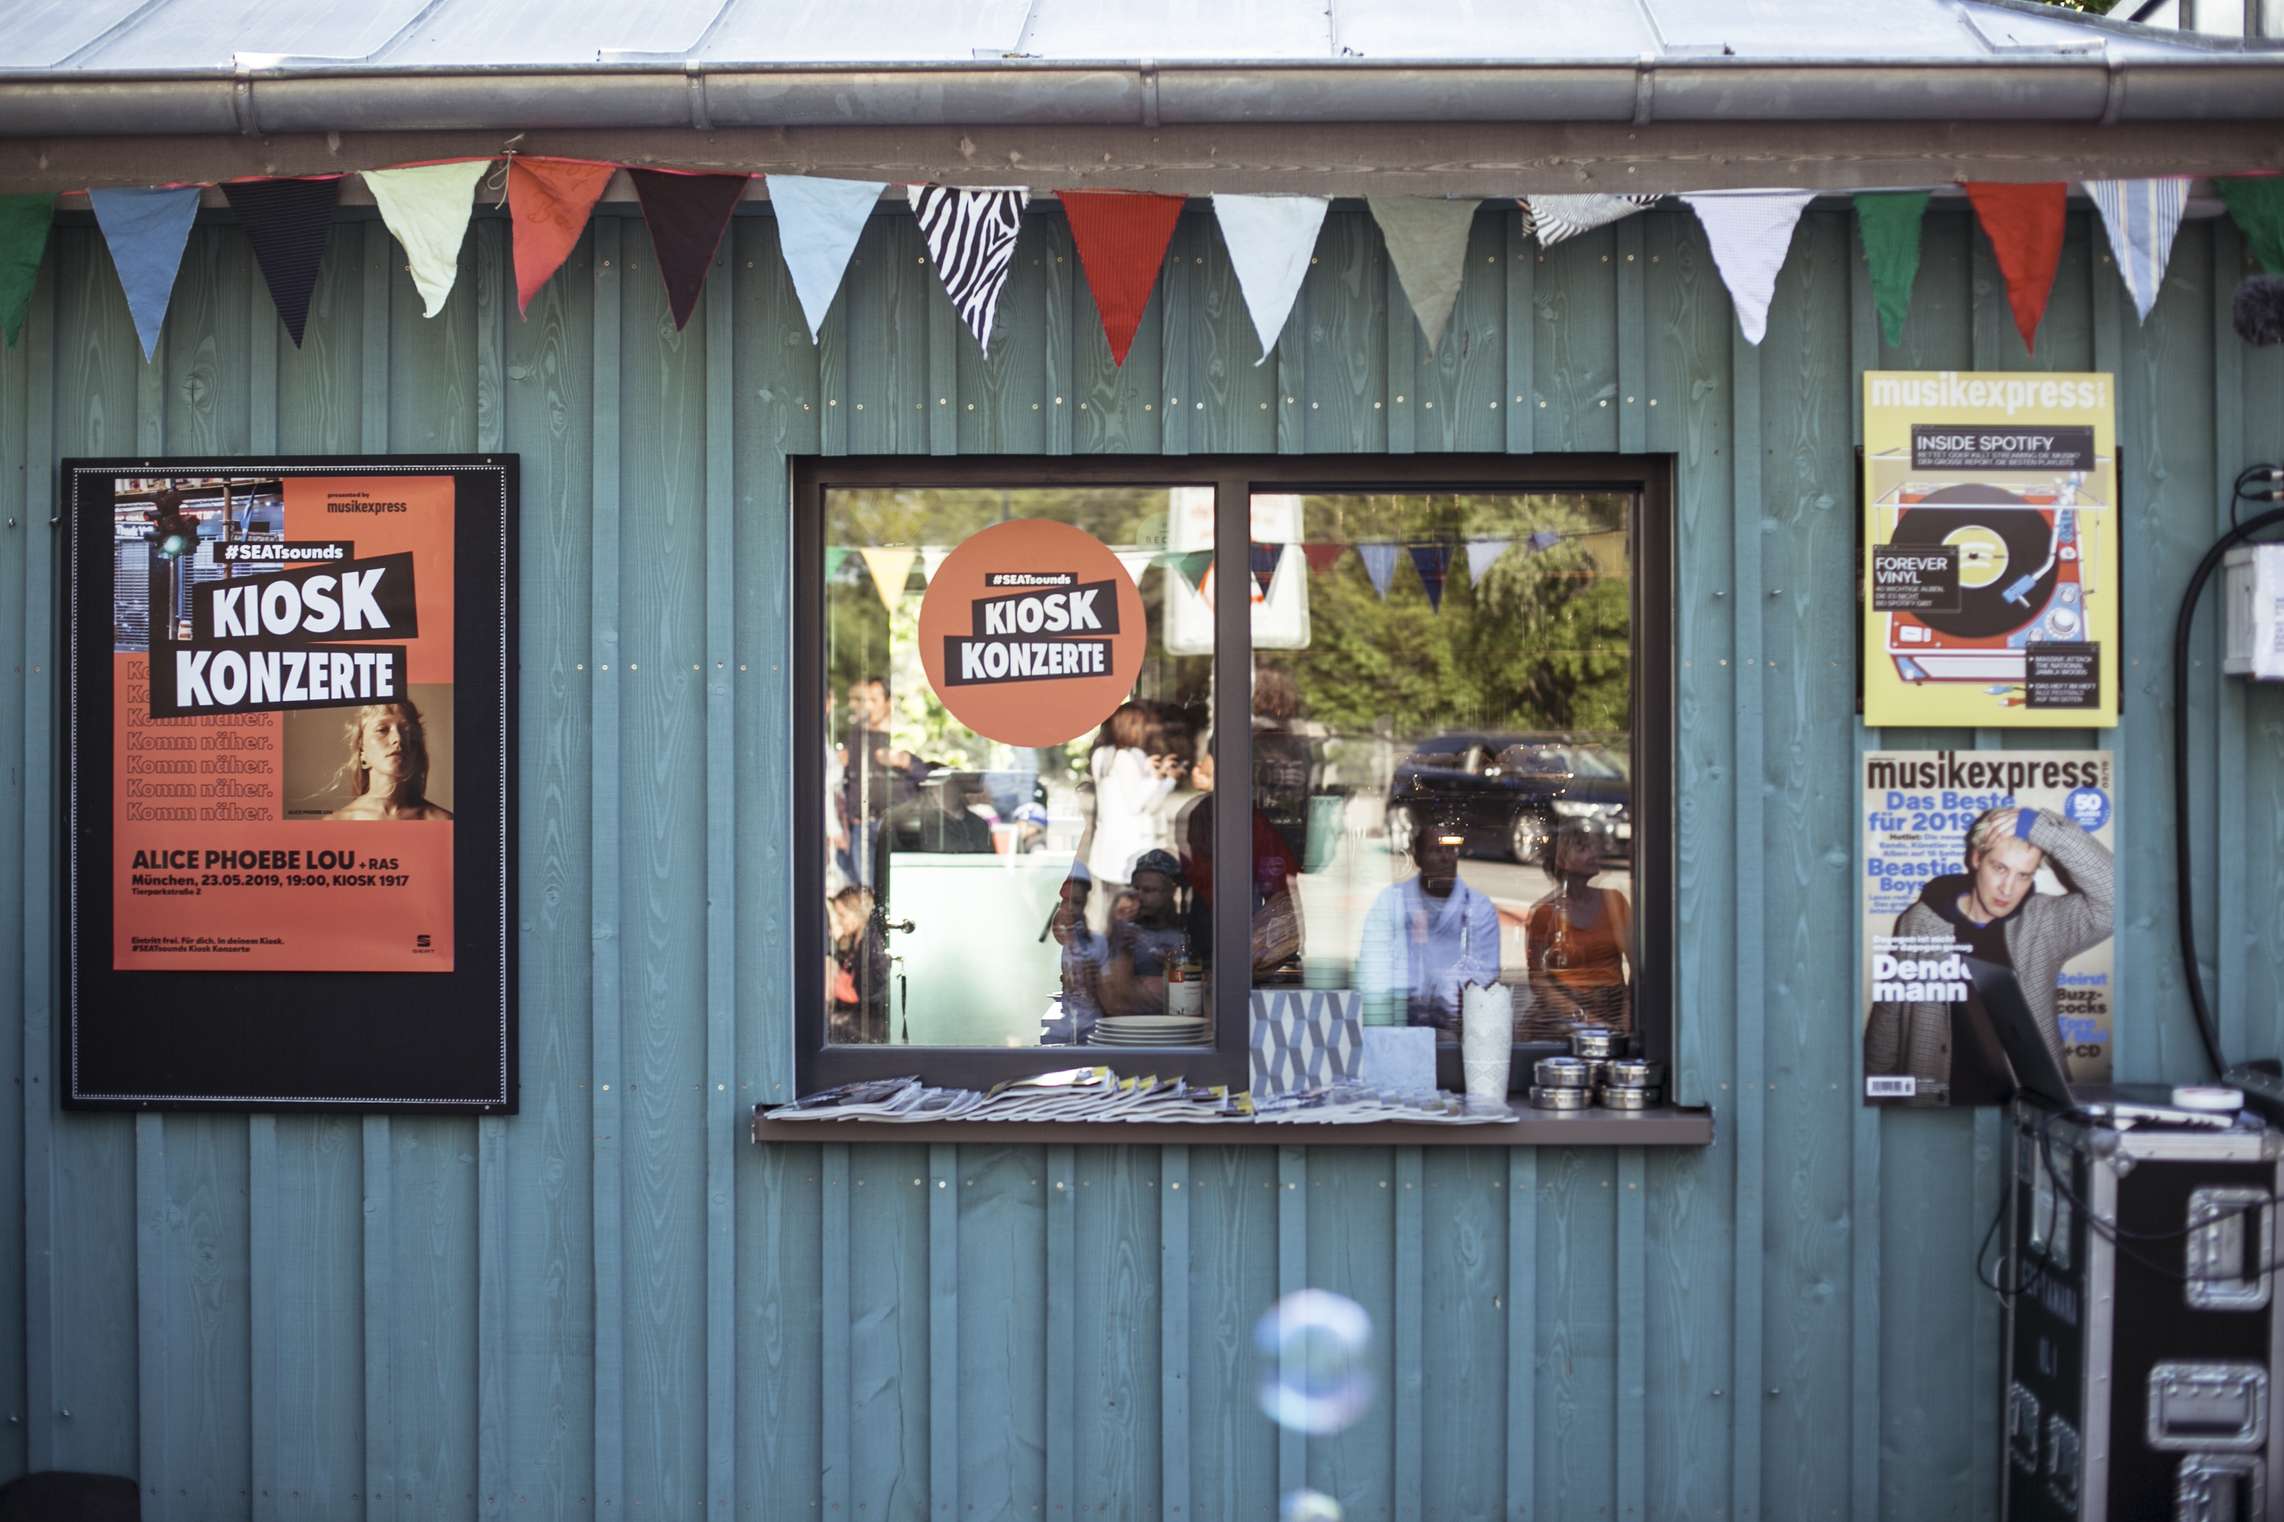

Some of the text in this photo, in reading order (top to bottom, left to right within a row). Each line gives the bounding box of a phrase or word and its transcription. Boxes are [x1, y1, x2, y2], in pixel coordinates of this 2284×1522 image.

[1871, 371, 2097, 416] musikexpress
[1917, 436, 2055, 450] INSIDE SPOTIFY
[327, 500, 407, 516] musikexpress
[225, 544, 344, 560] #SEATsounds
[1875, 557, 1948, 570] FOREVER
[992, 574, 1071, 585] #SEATsounds
[1876, 571, 1922, 584] VINYL
[212, 567, 391, 638] KIOSK
[984, 589, 1102, 636] KIOSK
[961, 641, 1105, 680] KONZERTE
[176, 650, 394, 708] KONZERTE
[127, 732, 274, 751] Komm näher.
[127, 755, 274, 774] Komm näher.
[1868, 751, 2098, 796] musikexpress
[127, 779, 274, 798] Komm näher.
[1887, 791, 2016, 810] Das Beste
[2074, 794, 2102, 810] 50
[127, 802, 274, 821] Komm näher.
[1868, 812, 1974, 831] für 2019
[132, 849, 199, 870] ALICE
[205, 849, 300, 870] PHOEBE
[306, 849, 355, 870] LOU
[368, 859, 399, 870] RAS
[1868, 858, 1962, 876] Beastie
[132, 874, 409, 887] München, 23.05.2019, 19:00, KIOSK 1917
[132, 888, 194, 896] Tierparkstraße
[132, 936, 161, 944] Eintritt
[260, 936, 285, 944] Kiosk.
[132, 944, 250, 952] #SEATsounds Kiosk Konzerte
[1873, 982, 1968, 1001] mann
[2056, 988, 2102, 1001] Buzz-
[2076, 1044, 2101, 1057] CD
